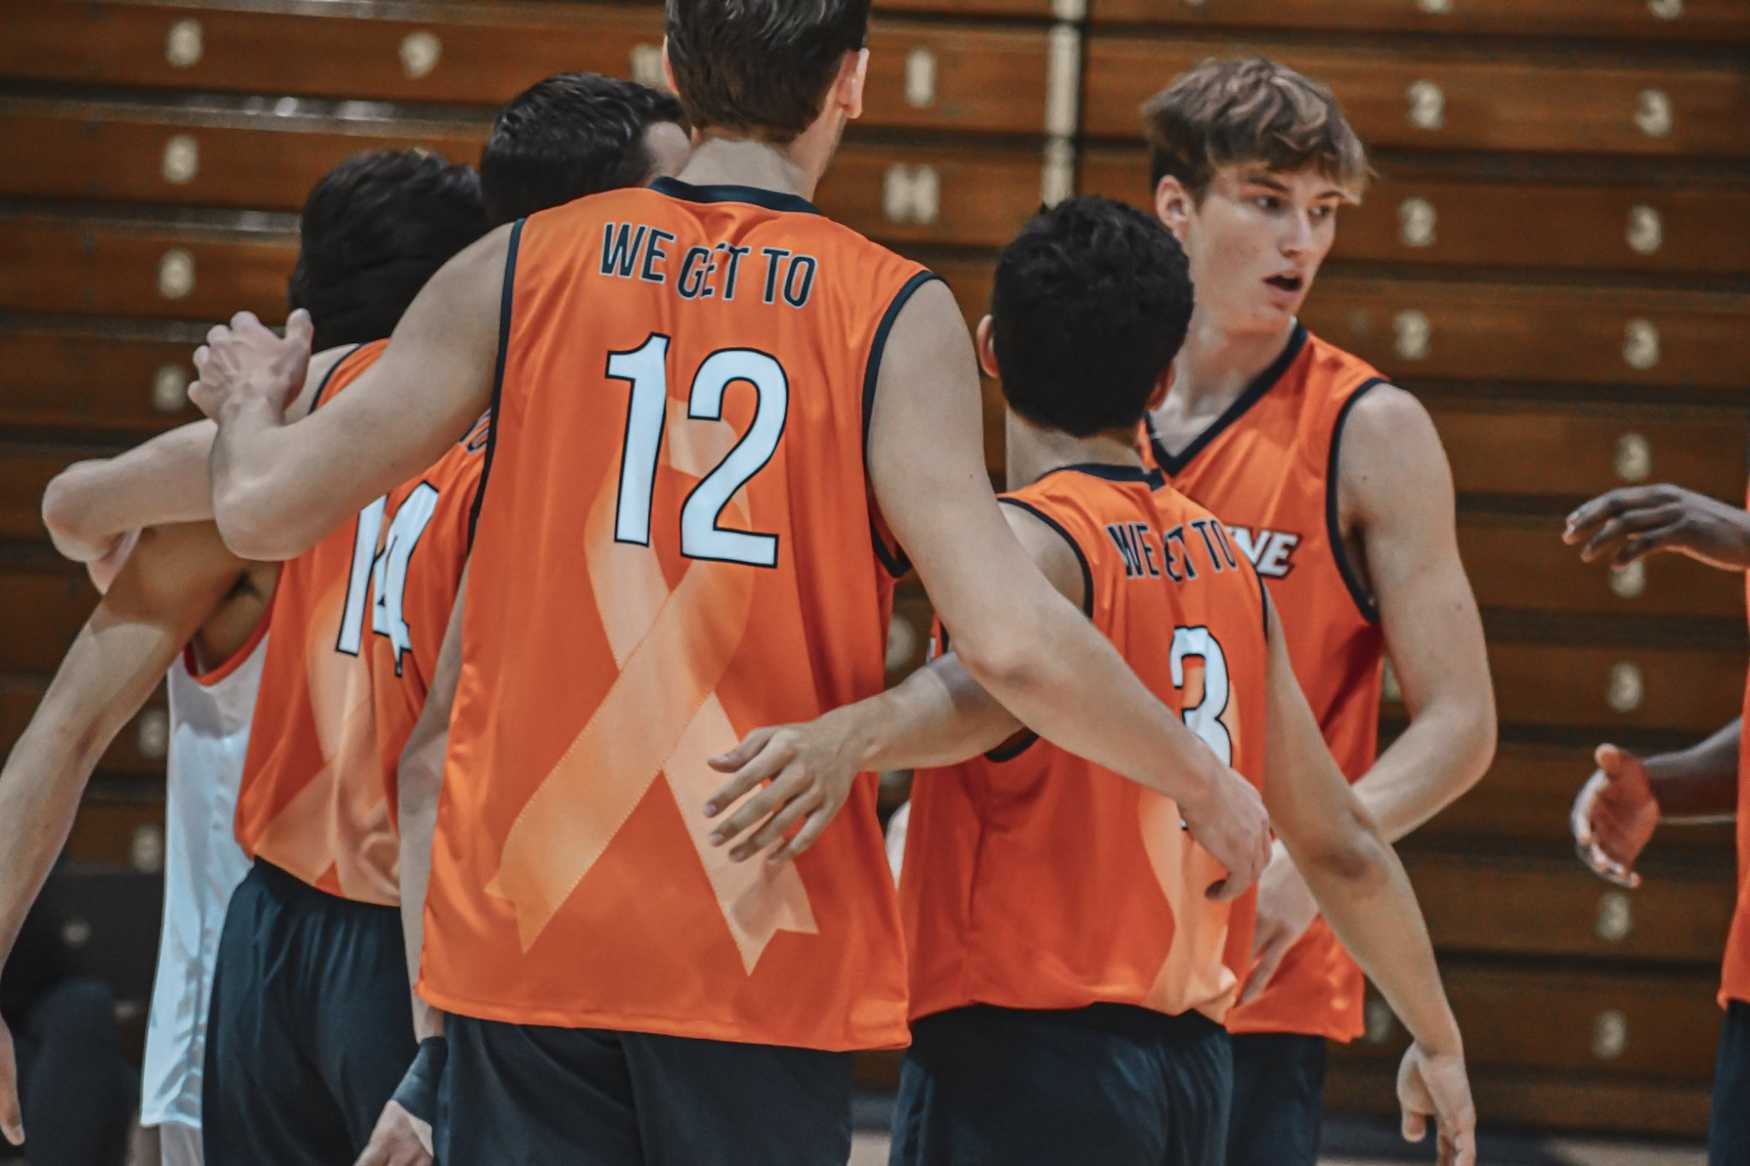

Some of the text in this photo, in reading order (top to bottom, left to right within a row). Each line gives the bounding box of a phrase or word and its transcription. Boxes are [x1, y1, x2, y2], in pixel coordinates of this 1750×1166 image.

[599, 222, 676, 283] WE
[761, 247, 818, 309] TO
[605, 332, 789, 569] 12
[1105, 522, 1159, 578] WE
[1169, 624, 1233, 769] 3
